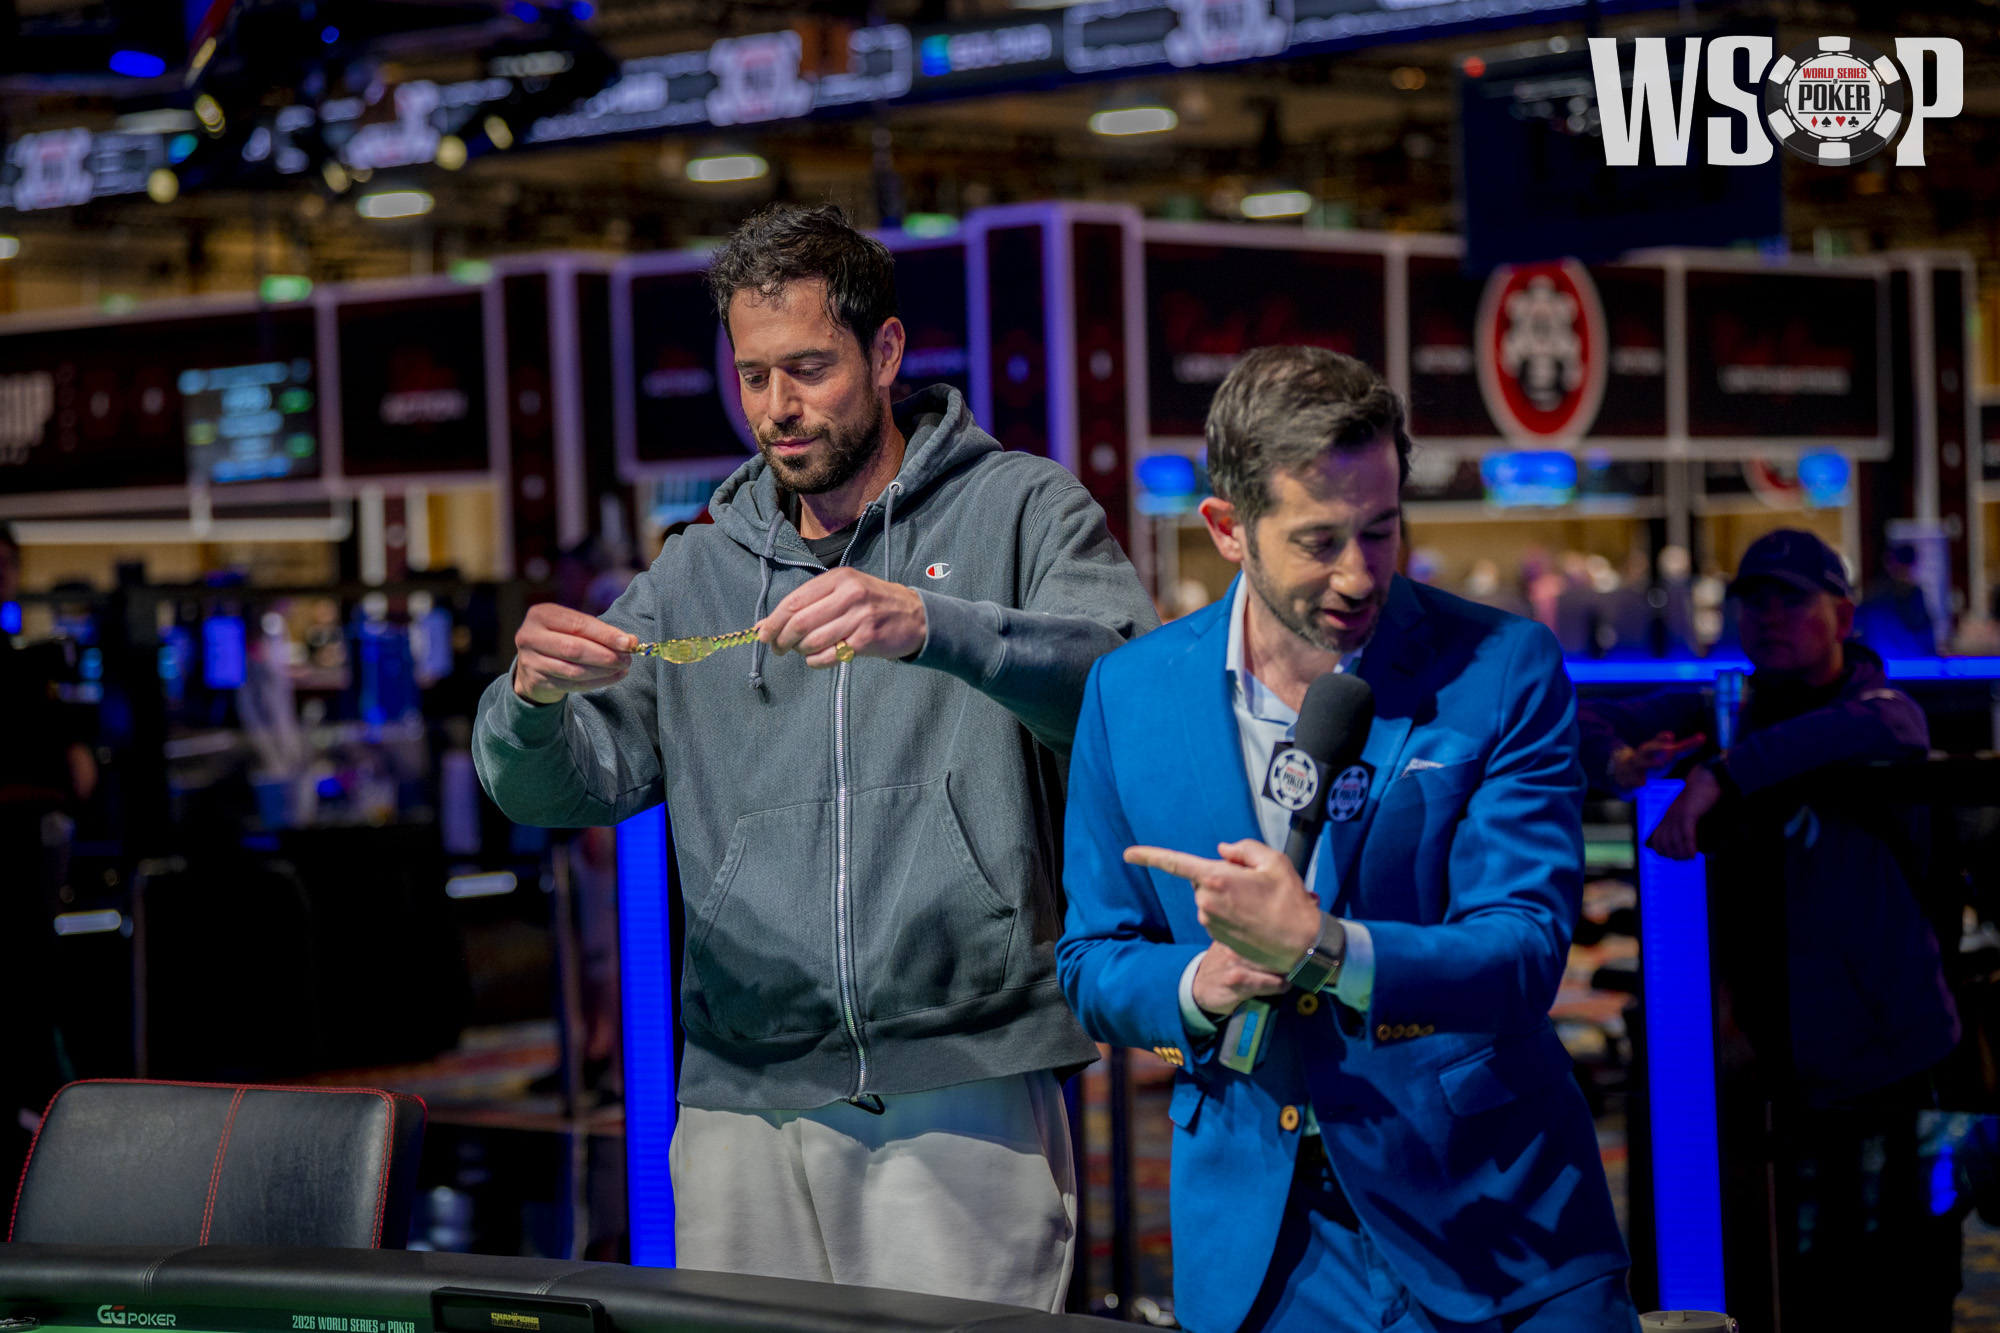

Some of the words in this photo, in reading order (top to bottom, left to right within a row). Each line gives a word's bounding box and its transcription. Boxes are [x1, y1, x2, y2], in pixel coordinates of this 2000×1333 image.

[292, 1315, 315, 1329] 2026
[317, 1316, 348, 1331] WORLD
[350, 1318, 379, 1333] SERIES
[387, 1320, 415, 1333] POKER
[490, 1312, 540, 1324] CHAMPIONS
